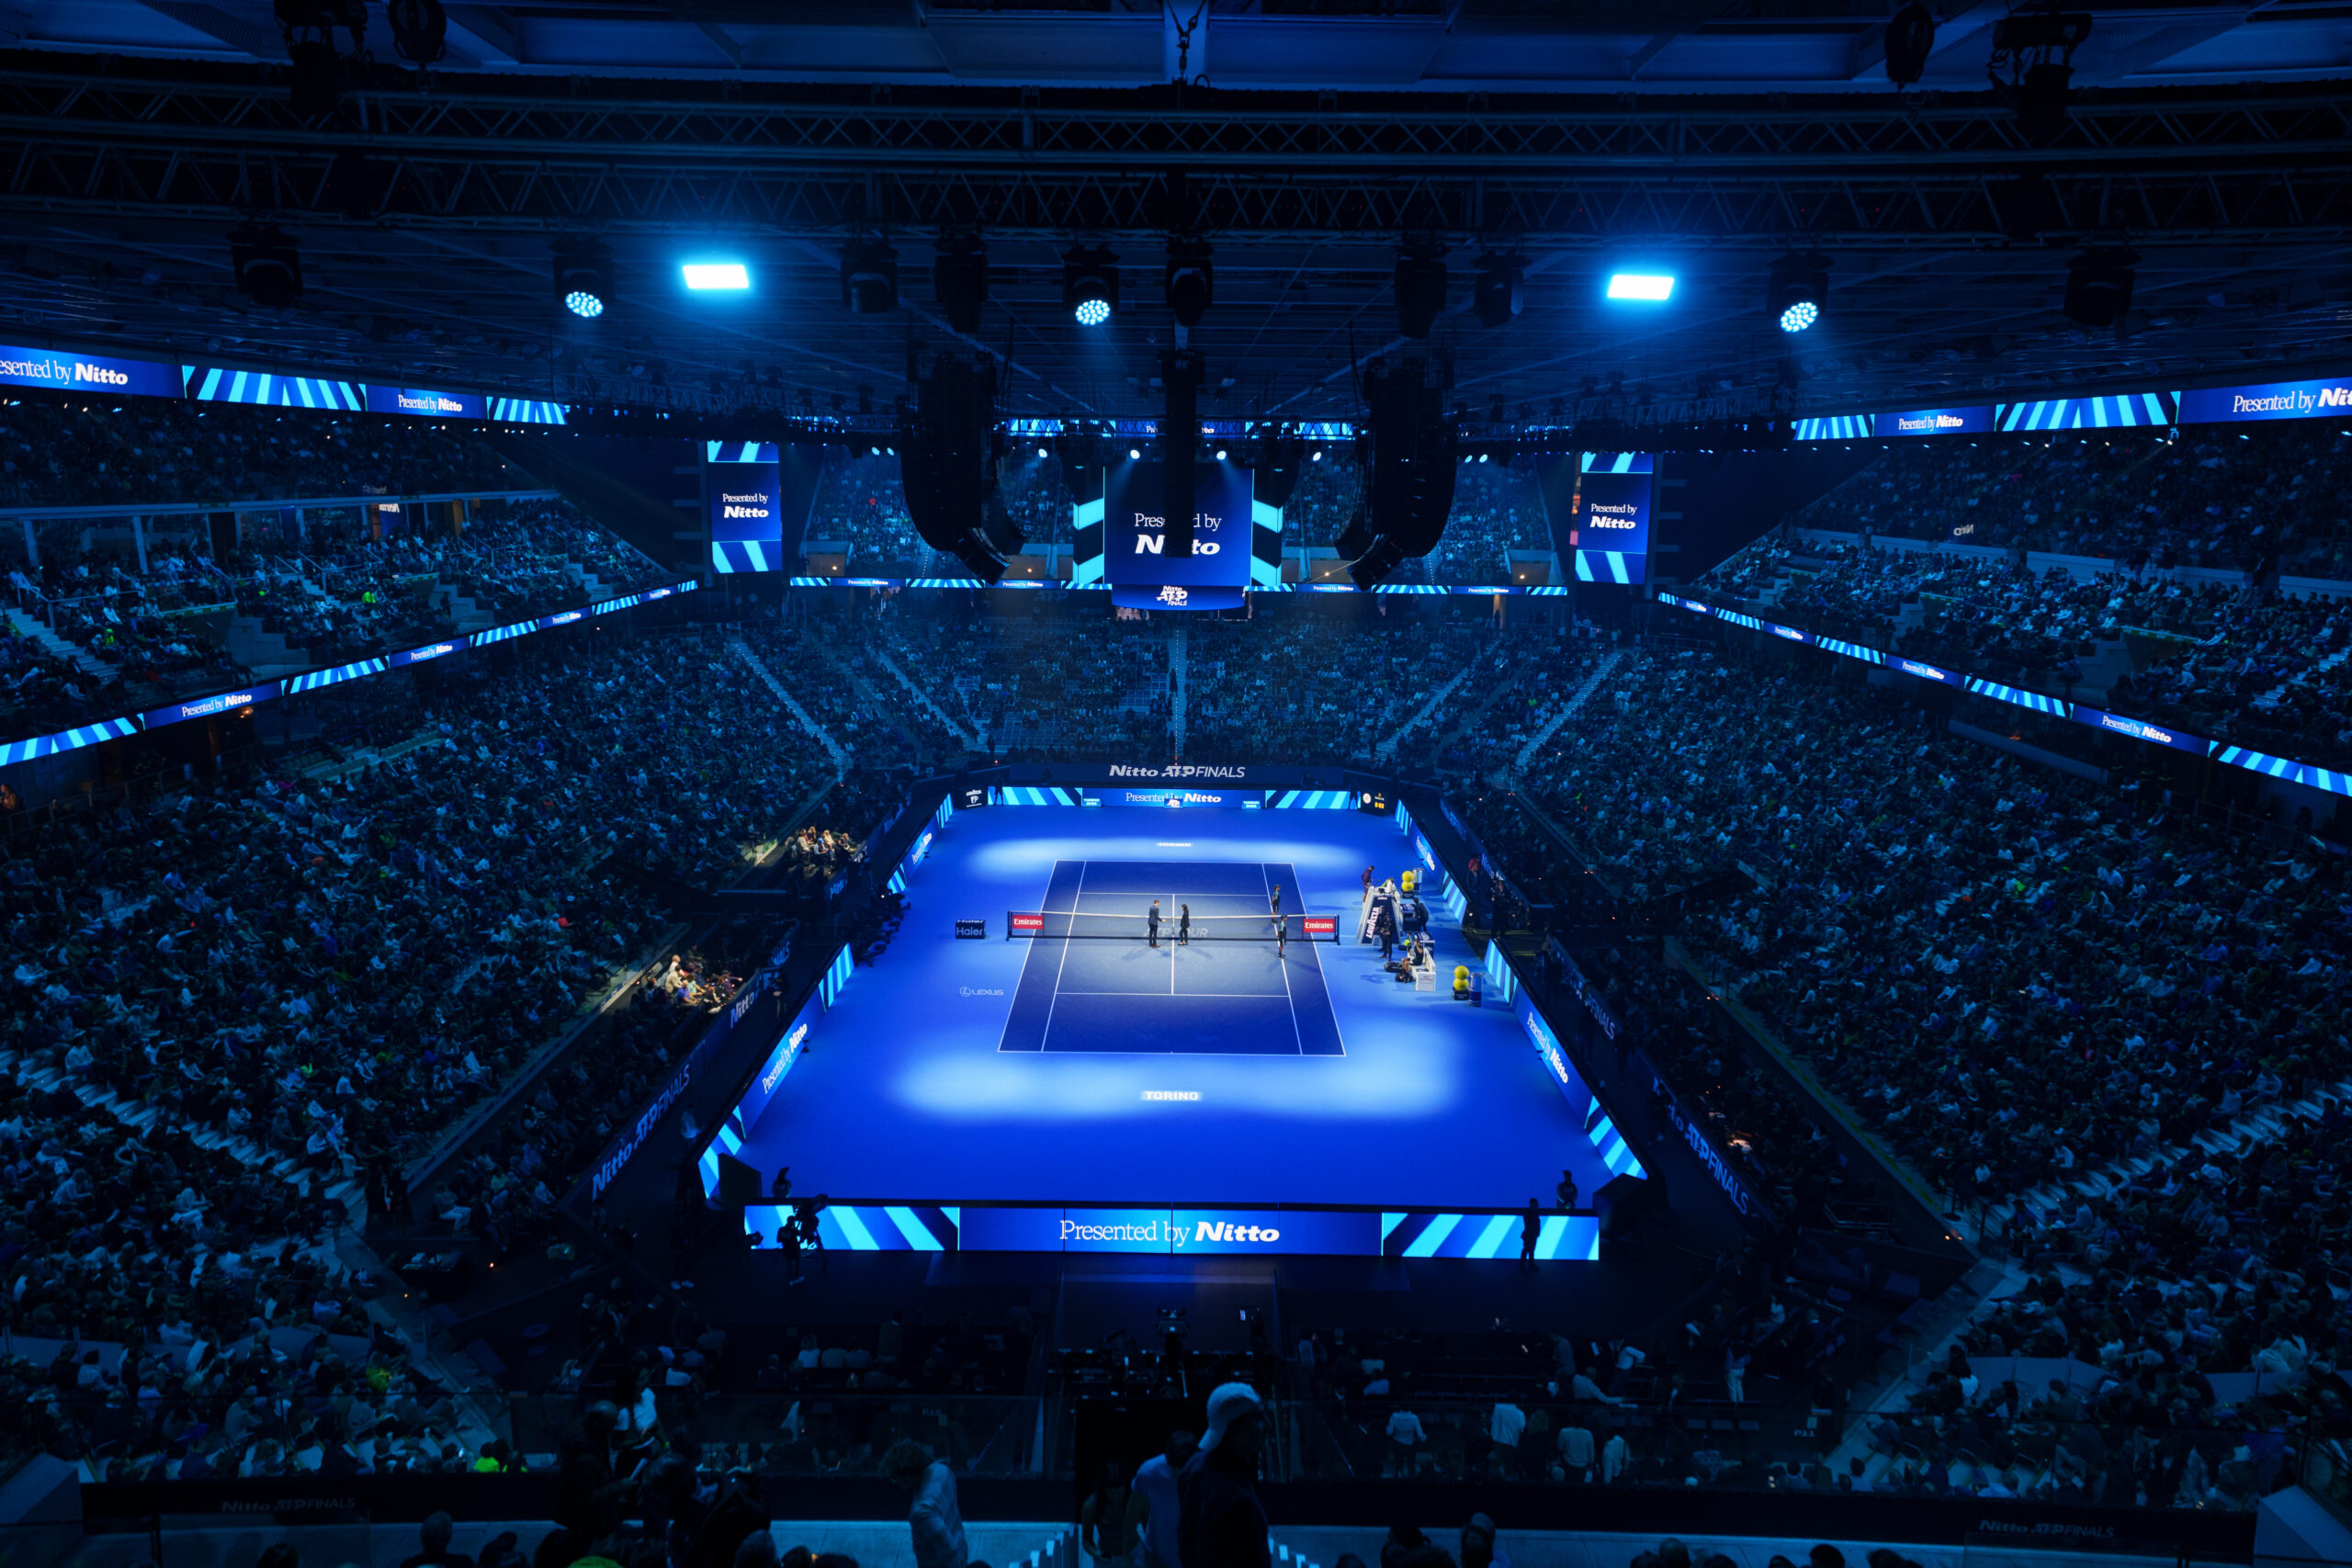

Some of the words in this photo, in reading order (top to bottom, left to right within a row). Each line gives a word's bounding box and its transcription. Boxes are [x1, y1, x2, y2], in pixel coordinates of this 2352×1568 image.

[53, 360, 71, 384] by
[74, 363, 129, 385] Nitto
[398, 394, 428, 410] Presented
[428, 397, 438, 413] by
[437, 398, 463, 412] Nitto
[2233, 390, 2295, 412] Presented
[2298, 389, 2316, 413] by
[1898, 416, 1927, 430] Presented
[1928, 416, 1936, 432] by
[1936, 415, 1963, 428] Nitto
[722, 492, 758, 502] Presented
[758, 492, 769, 504] by
[723, 505, 769, 519] Nitto
[1590, 502, 1626, 513] Presented
[1626, 503, 1637, 515] by
[1134, 513, 1201, 527] Presd
[1203, 513, 1222, 532] by
[1589, 515, 1636, 530] Nitto
[1135, 534, 1221, 555] Nto
[1155, 591, 1188, 602] ATP
[182, 700, 214, 717] Presented
[215, 698, 223, 712] by
[224, 694, 252, 707] Nitto
[2102, 715, 2132, 732] Presented
[2132, 723, 2142, 738] by
[2142, 726, 2172, 743] Nitto
[1109, 764, 1159, 777] Nitto
[1194, 766, 1245, 778] FINALS
[1183, 793, 1222, 803] Nitto
[956, 927, 983, 936] Haier
[789, 1022, 808, 1054] Nitto
[1549, 1047, 1568, 1083] Nitto
[1144, 1089, 1199, 1100] TORINO
[592, 1142, 633, 1202] Nitto
[1708, 1150, 1749, 1216] FINALS
[1059, 1220, 1158, 1241] Presented
[1163, 1220, 1192, 1247] by
[1194, 1221, 1281, 1242] Nitto
[220, 1500, 272, 1513] Nitto
[1978, 1518, 2029, 1534] Nitto
